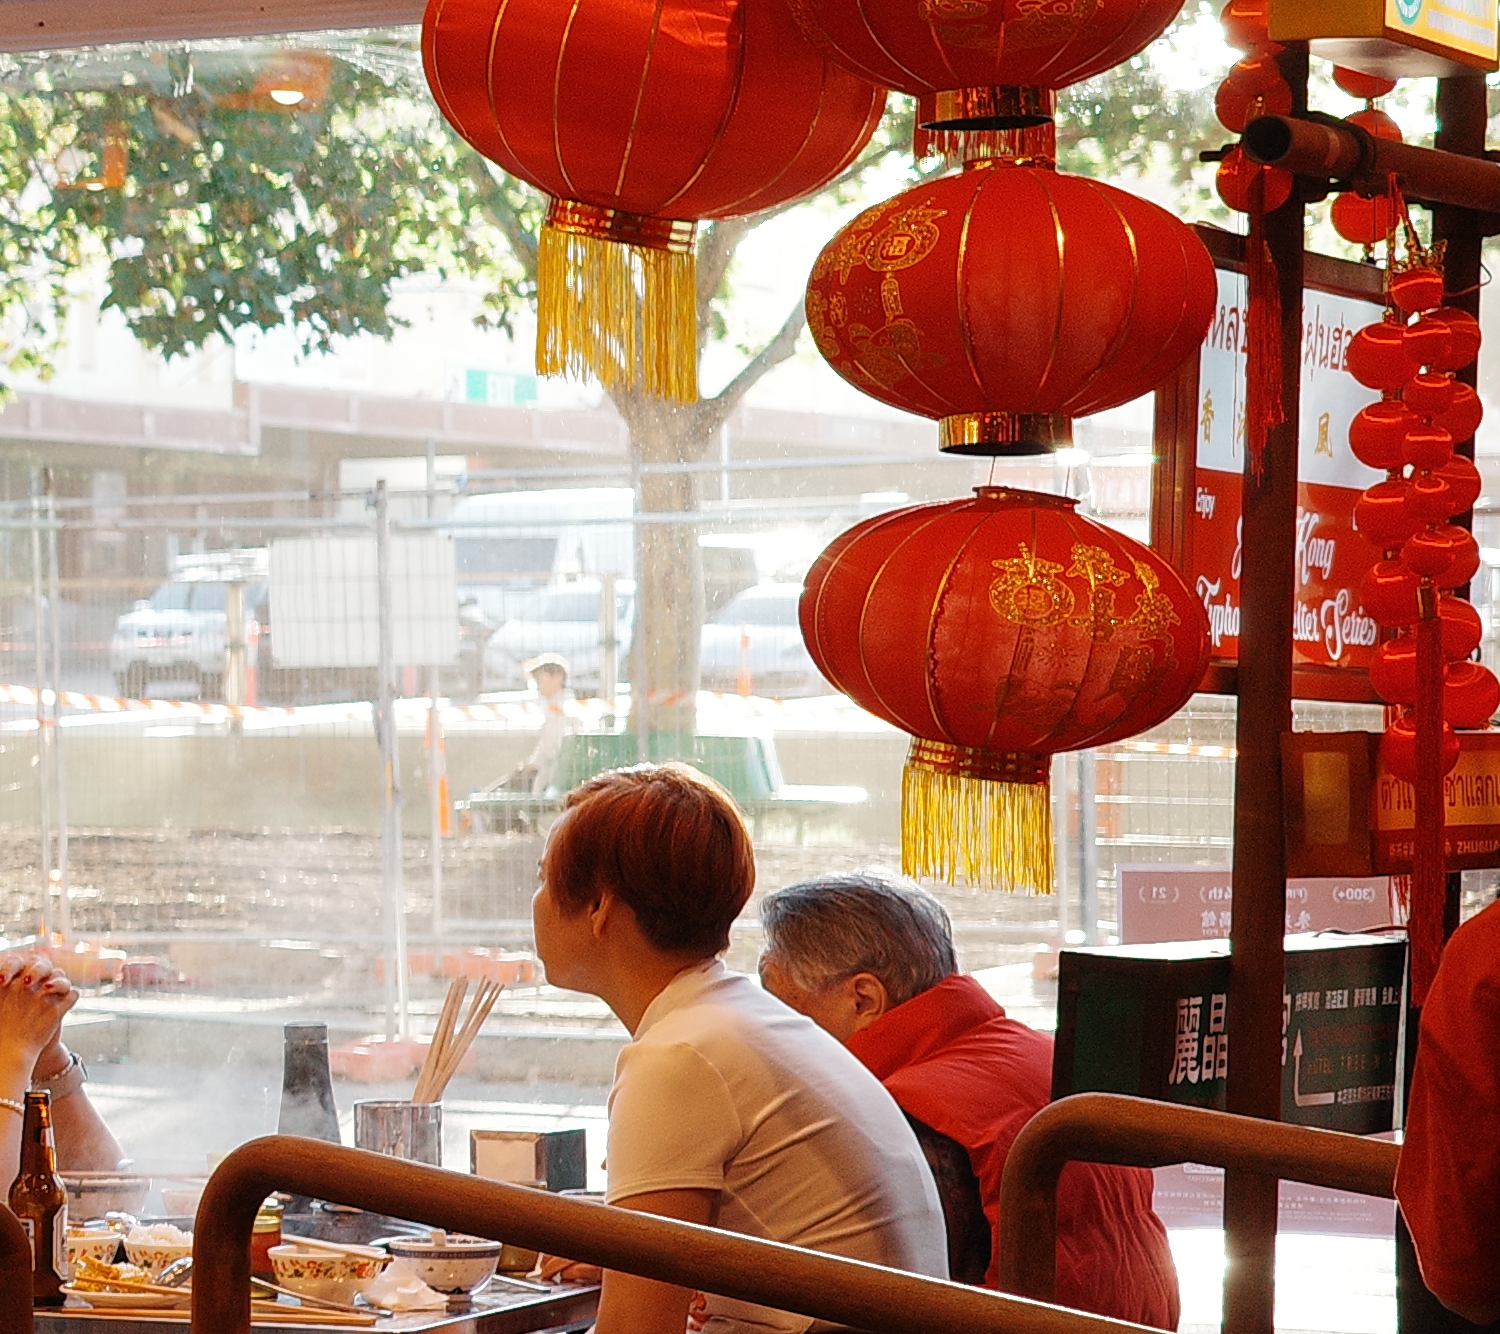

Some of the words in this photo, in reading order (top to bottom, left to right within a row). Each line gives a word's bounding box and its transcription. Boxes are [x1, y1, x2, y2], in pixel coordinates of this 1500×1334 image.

[1196, 486, 1217, 521] Enjoy
[1295, 512, 1337, 585] Kong
[1196, 574, 1241, 648] Typho
[1320, 587, 1379, 662] Series
